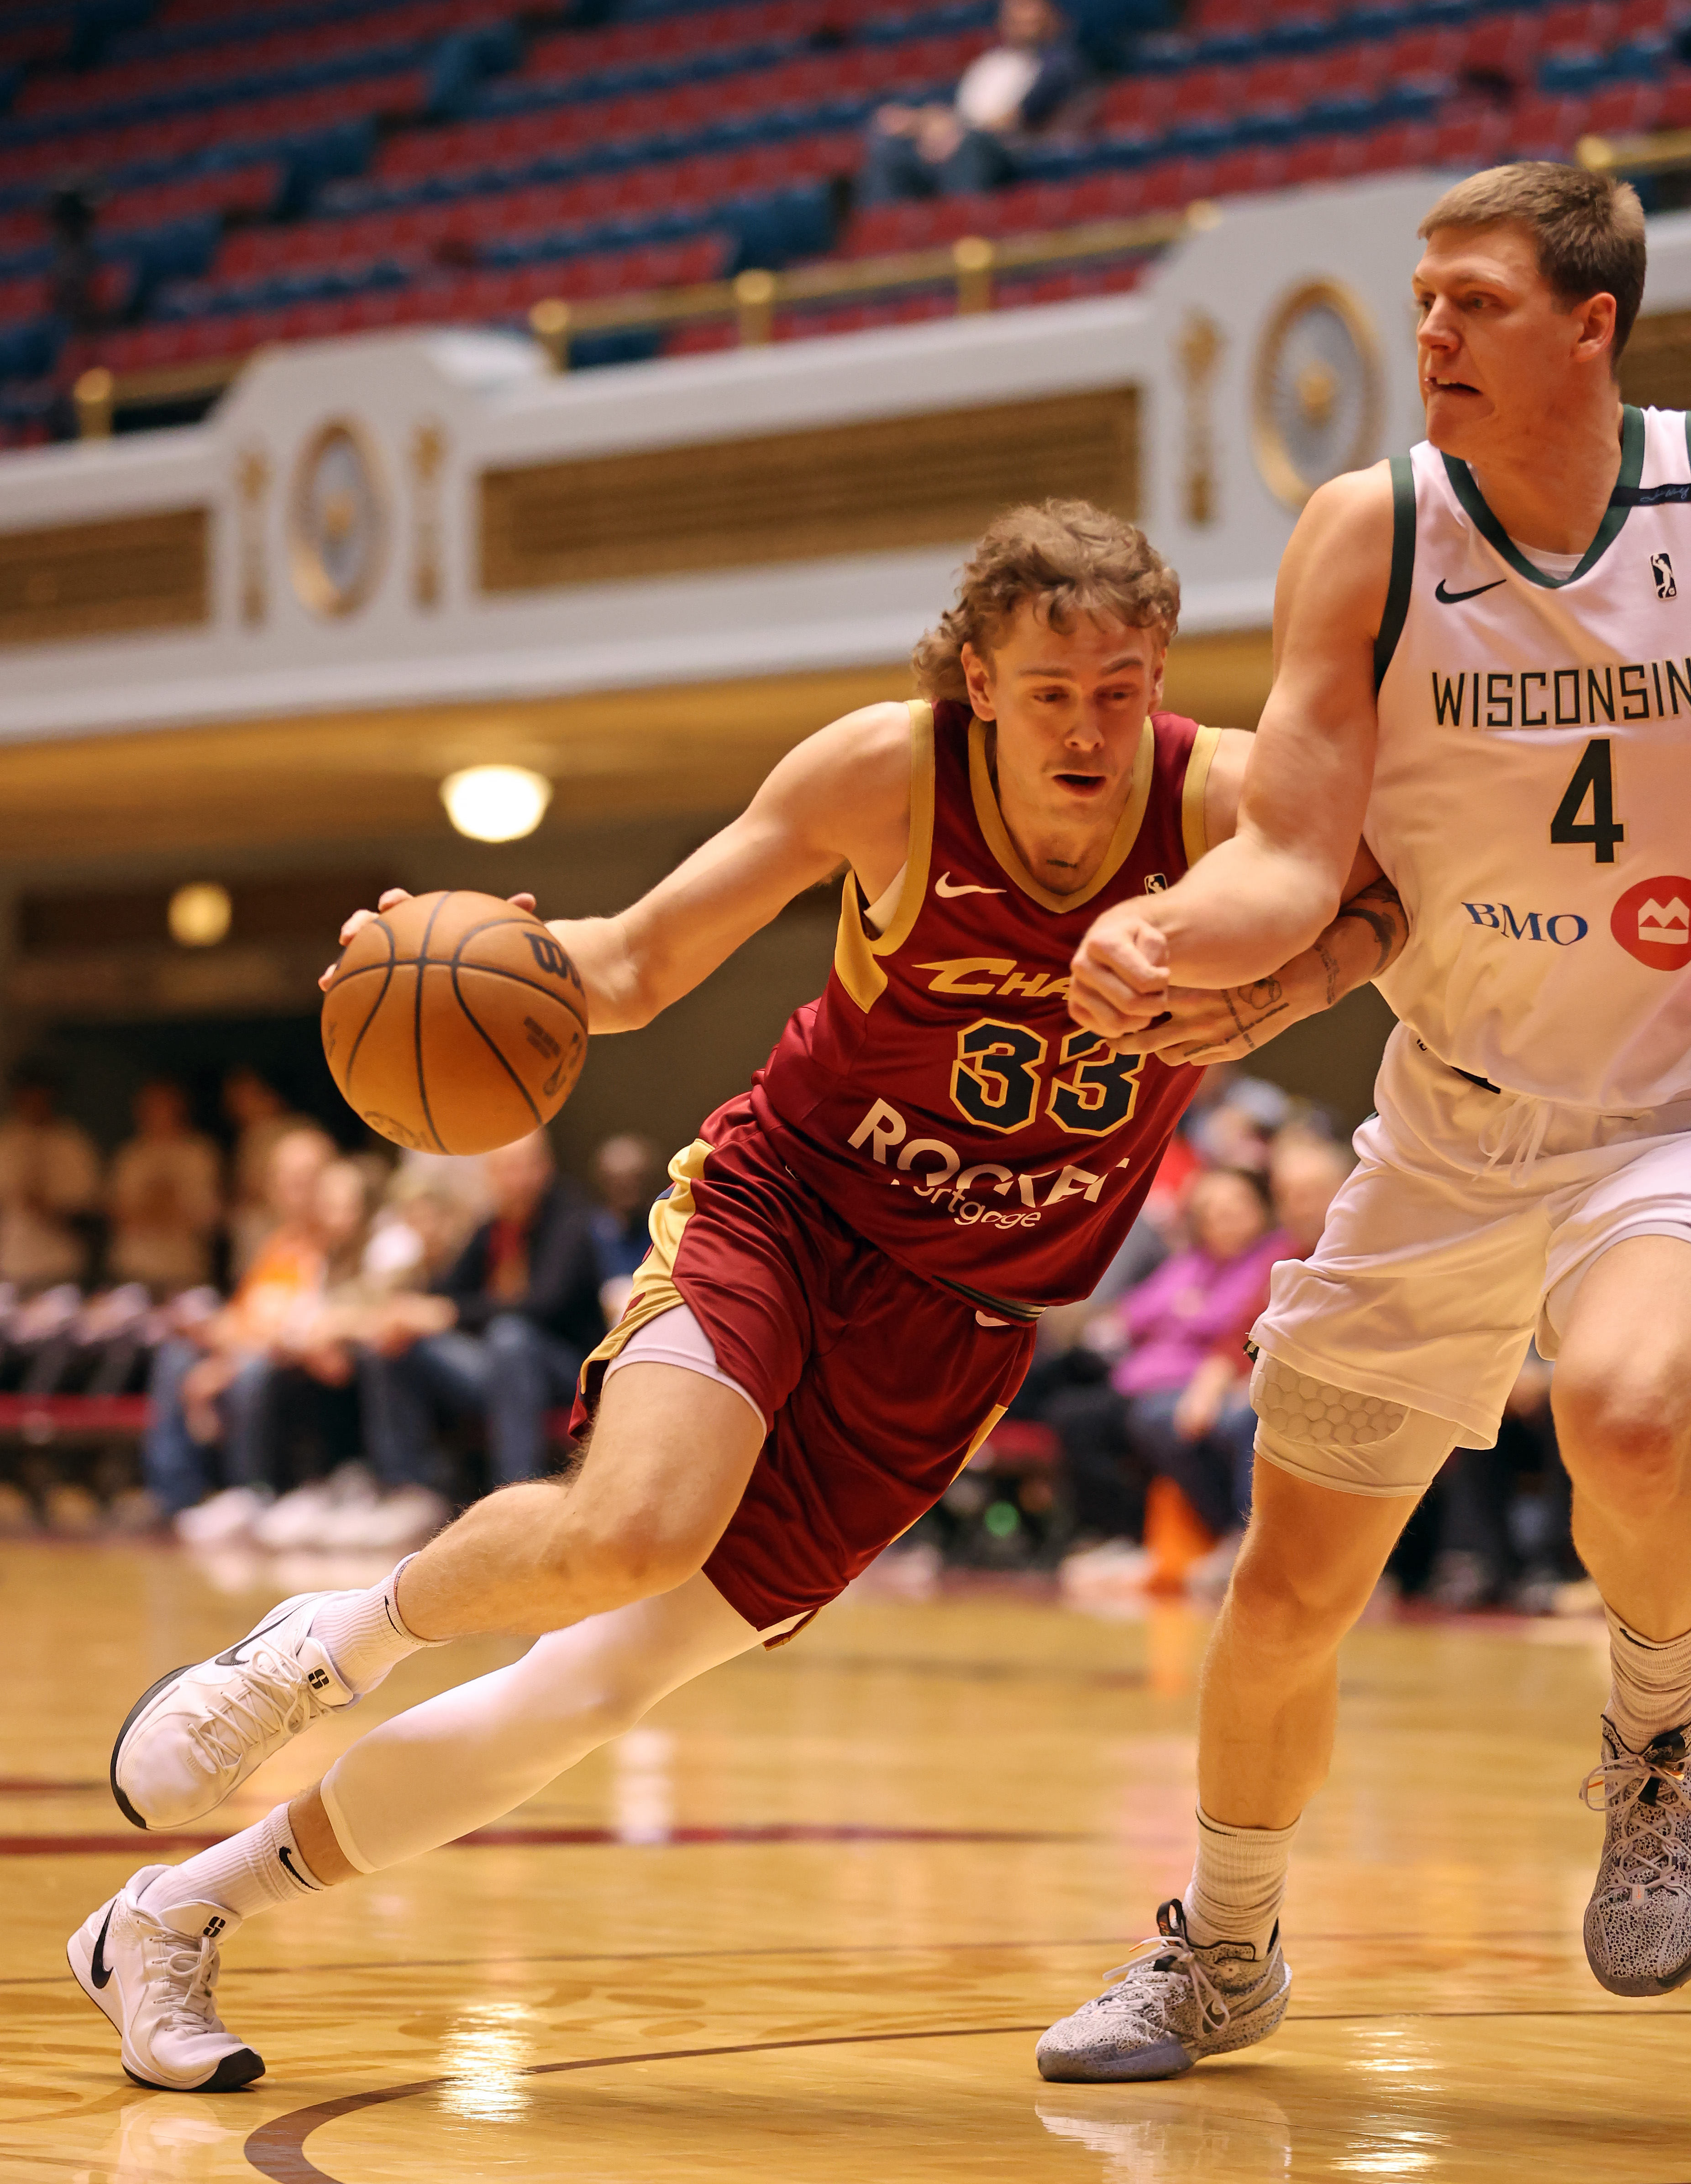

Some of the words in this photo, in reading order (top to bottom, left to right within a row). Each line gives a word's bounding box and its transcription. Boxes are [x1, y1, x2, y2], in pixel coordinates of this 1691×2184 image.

[1432, 657, 1691, 727] WISCONSIN
[1550, 738, 1624, 864] 4
[1461, 902, 1588, 946] BMO
[911, 957, 1071, 1000] CHA
[950, 1018, 1147, 1137] 33
[890, 1176, 1041, 1229] rtgage
